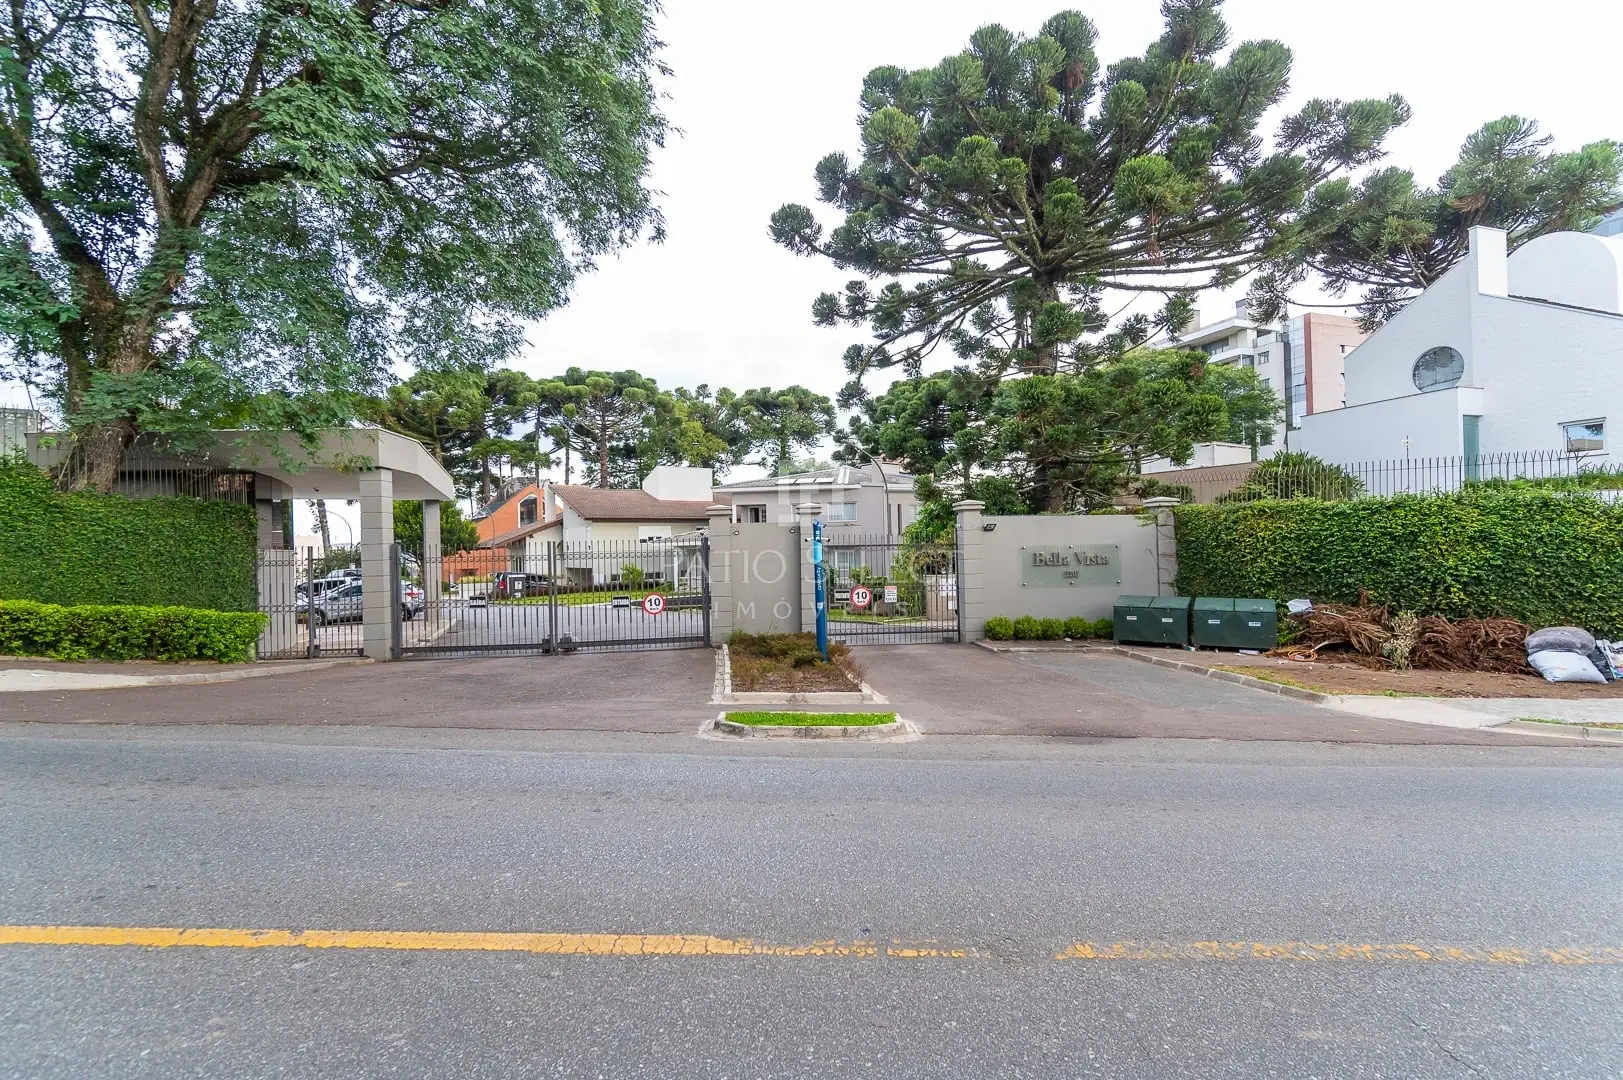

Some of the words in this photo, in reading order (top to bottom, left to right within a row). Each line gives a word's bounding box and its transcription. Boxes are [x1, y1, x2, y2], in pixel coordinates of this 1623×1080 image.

[1032, 551, 1070, 567] Bella
[1074, 551, 1109, 566] Vista
[855, 591, 868, 600] 10
[647, 597, 661, 607] 10
